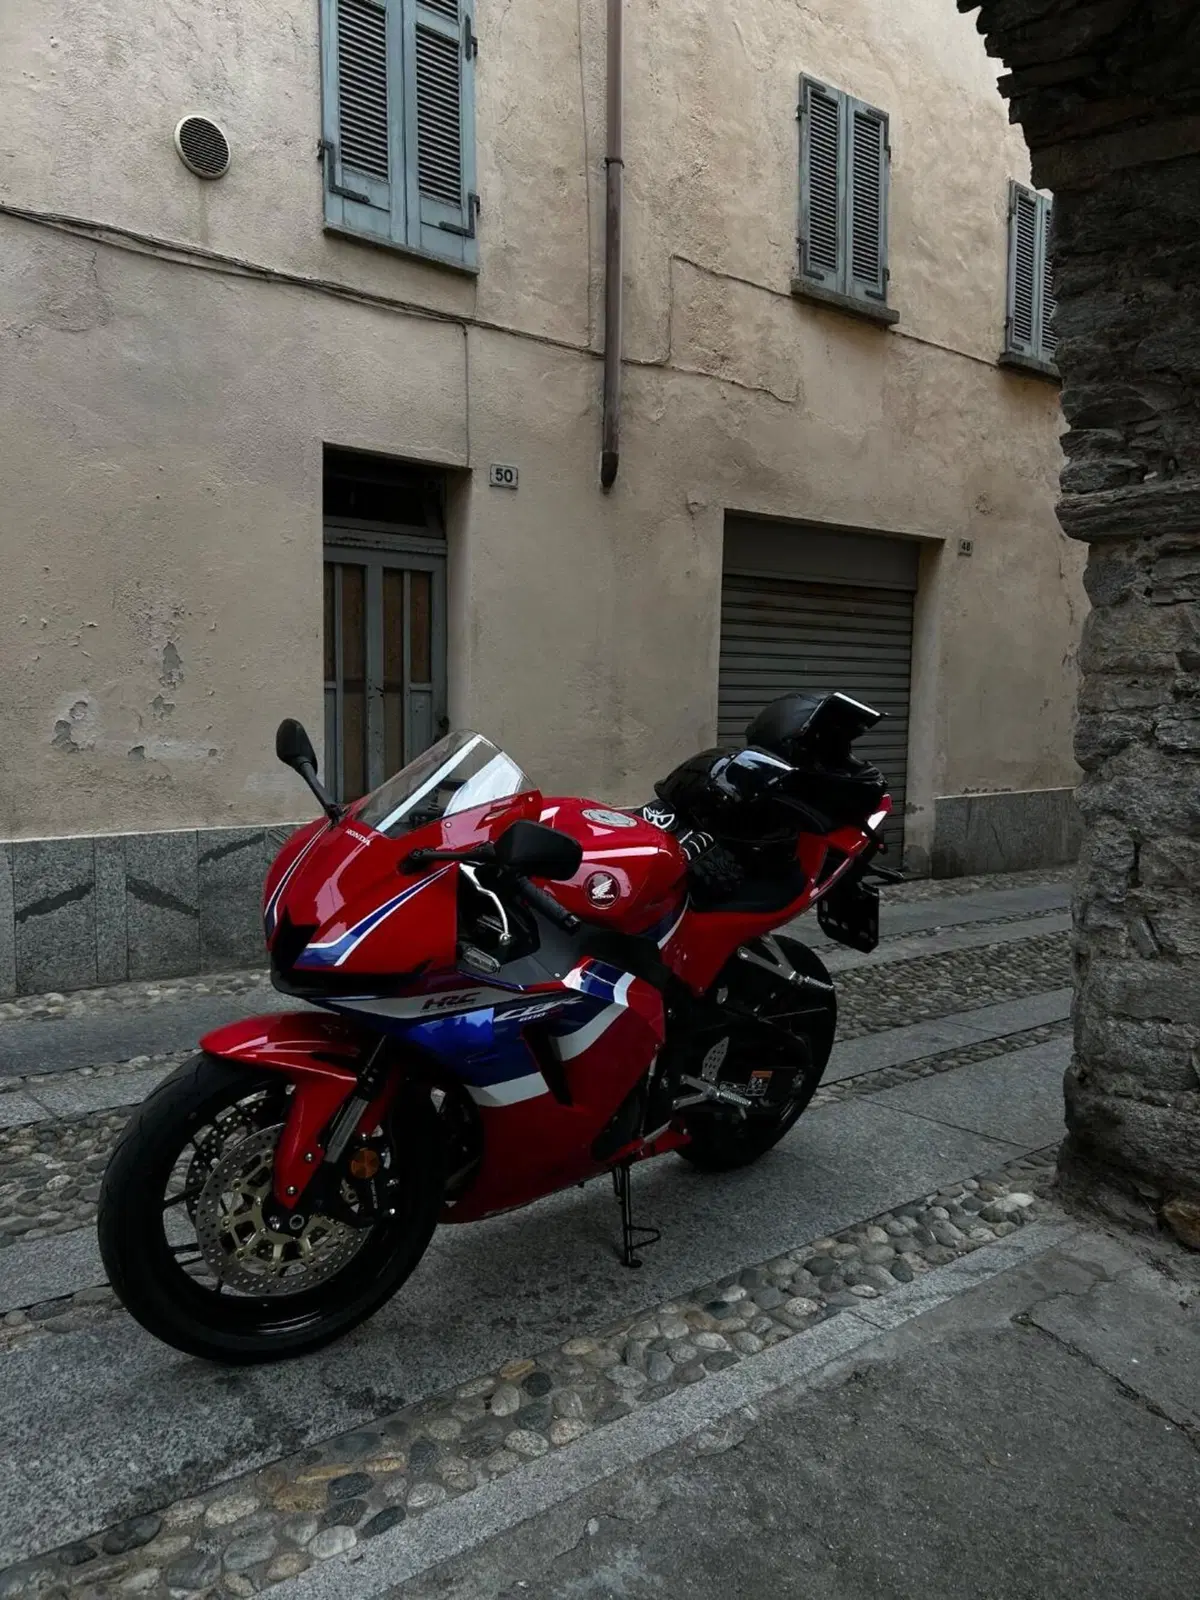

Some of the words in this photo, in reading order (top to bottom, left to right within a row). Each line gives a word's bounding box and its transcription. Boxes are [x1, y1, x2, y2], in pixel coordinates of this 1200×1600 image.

[495, 468, 513, 483] 50
[345, 828, 371, 847] HONDA
[422, 991, 482, 1010] HRC
